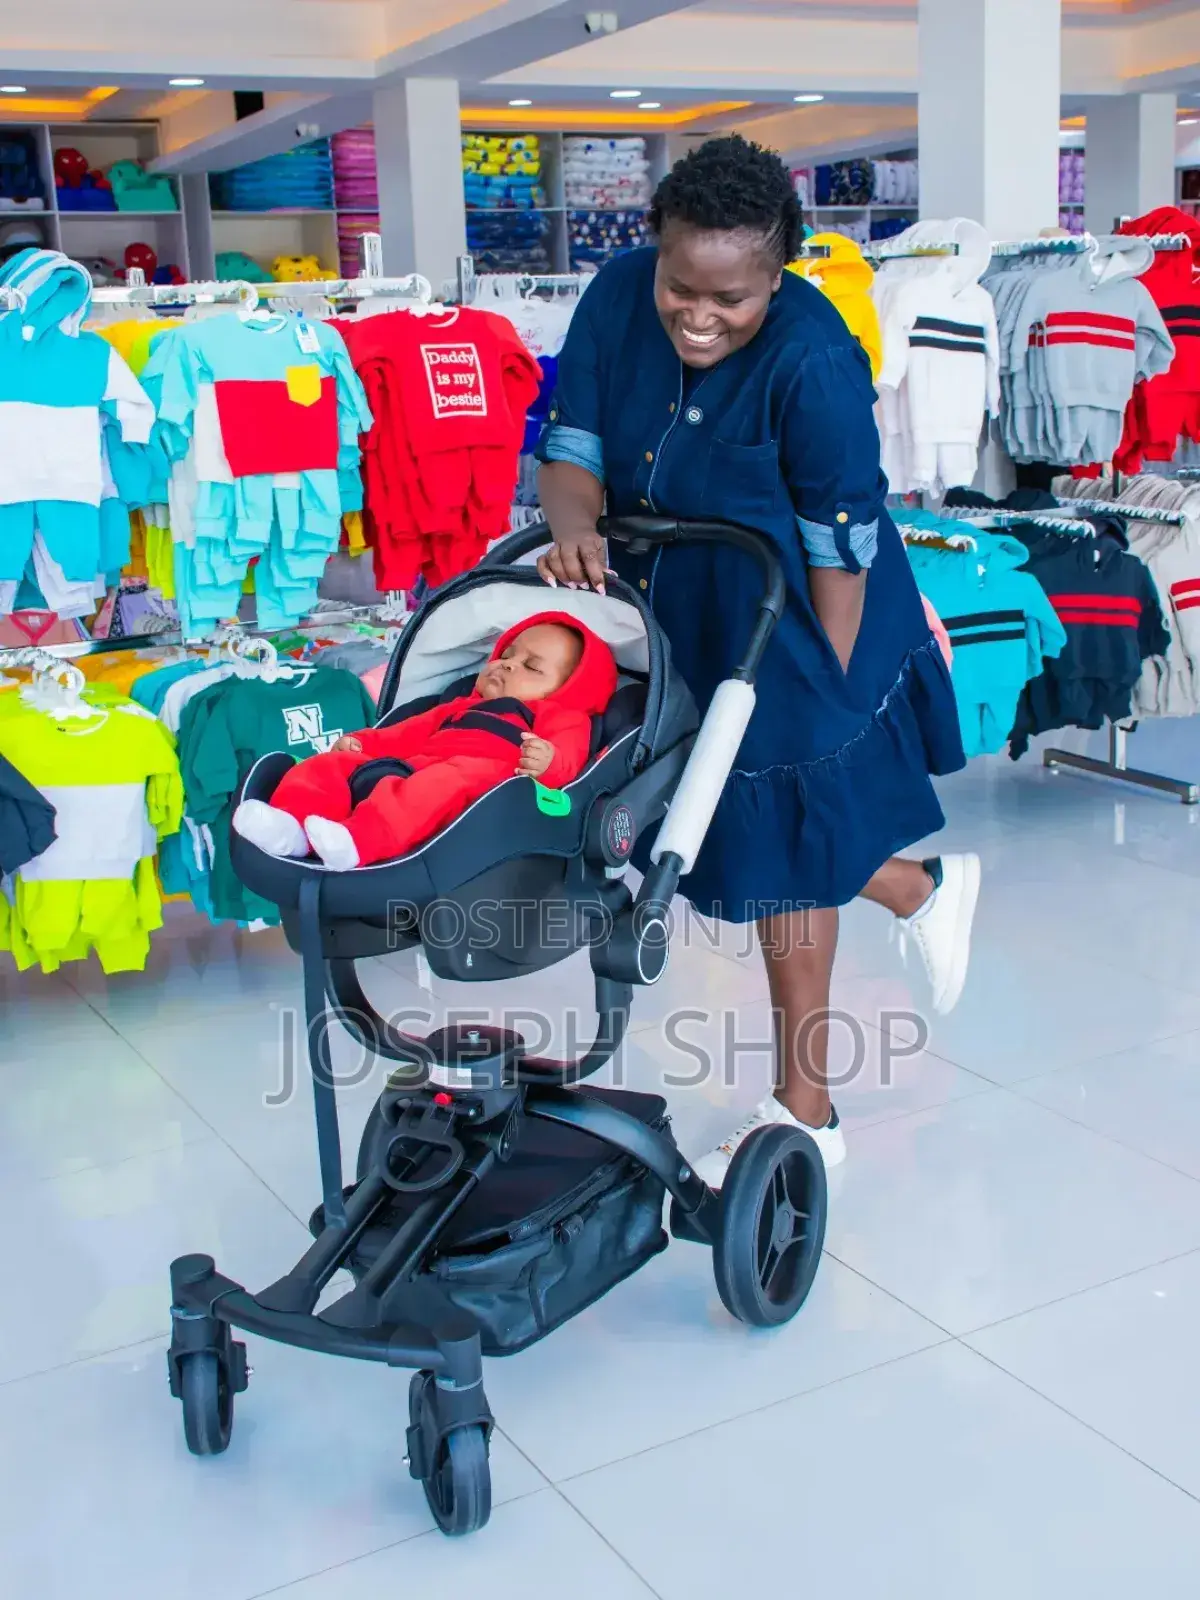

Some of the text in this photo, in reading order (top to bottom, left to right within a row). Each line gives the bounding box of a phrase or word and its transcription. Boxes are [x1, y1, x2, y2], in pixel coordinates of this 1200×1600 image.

[426, 351, 475, 367] Daddy
[436, 371, 476, 388] is my
[436, 391, 482, 408] bestie
